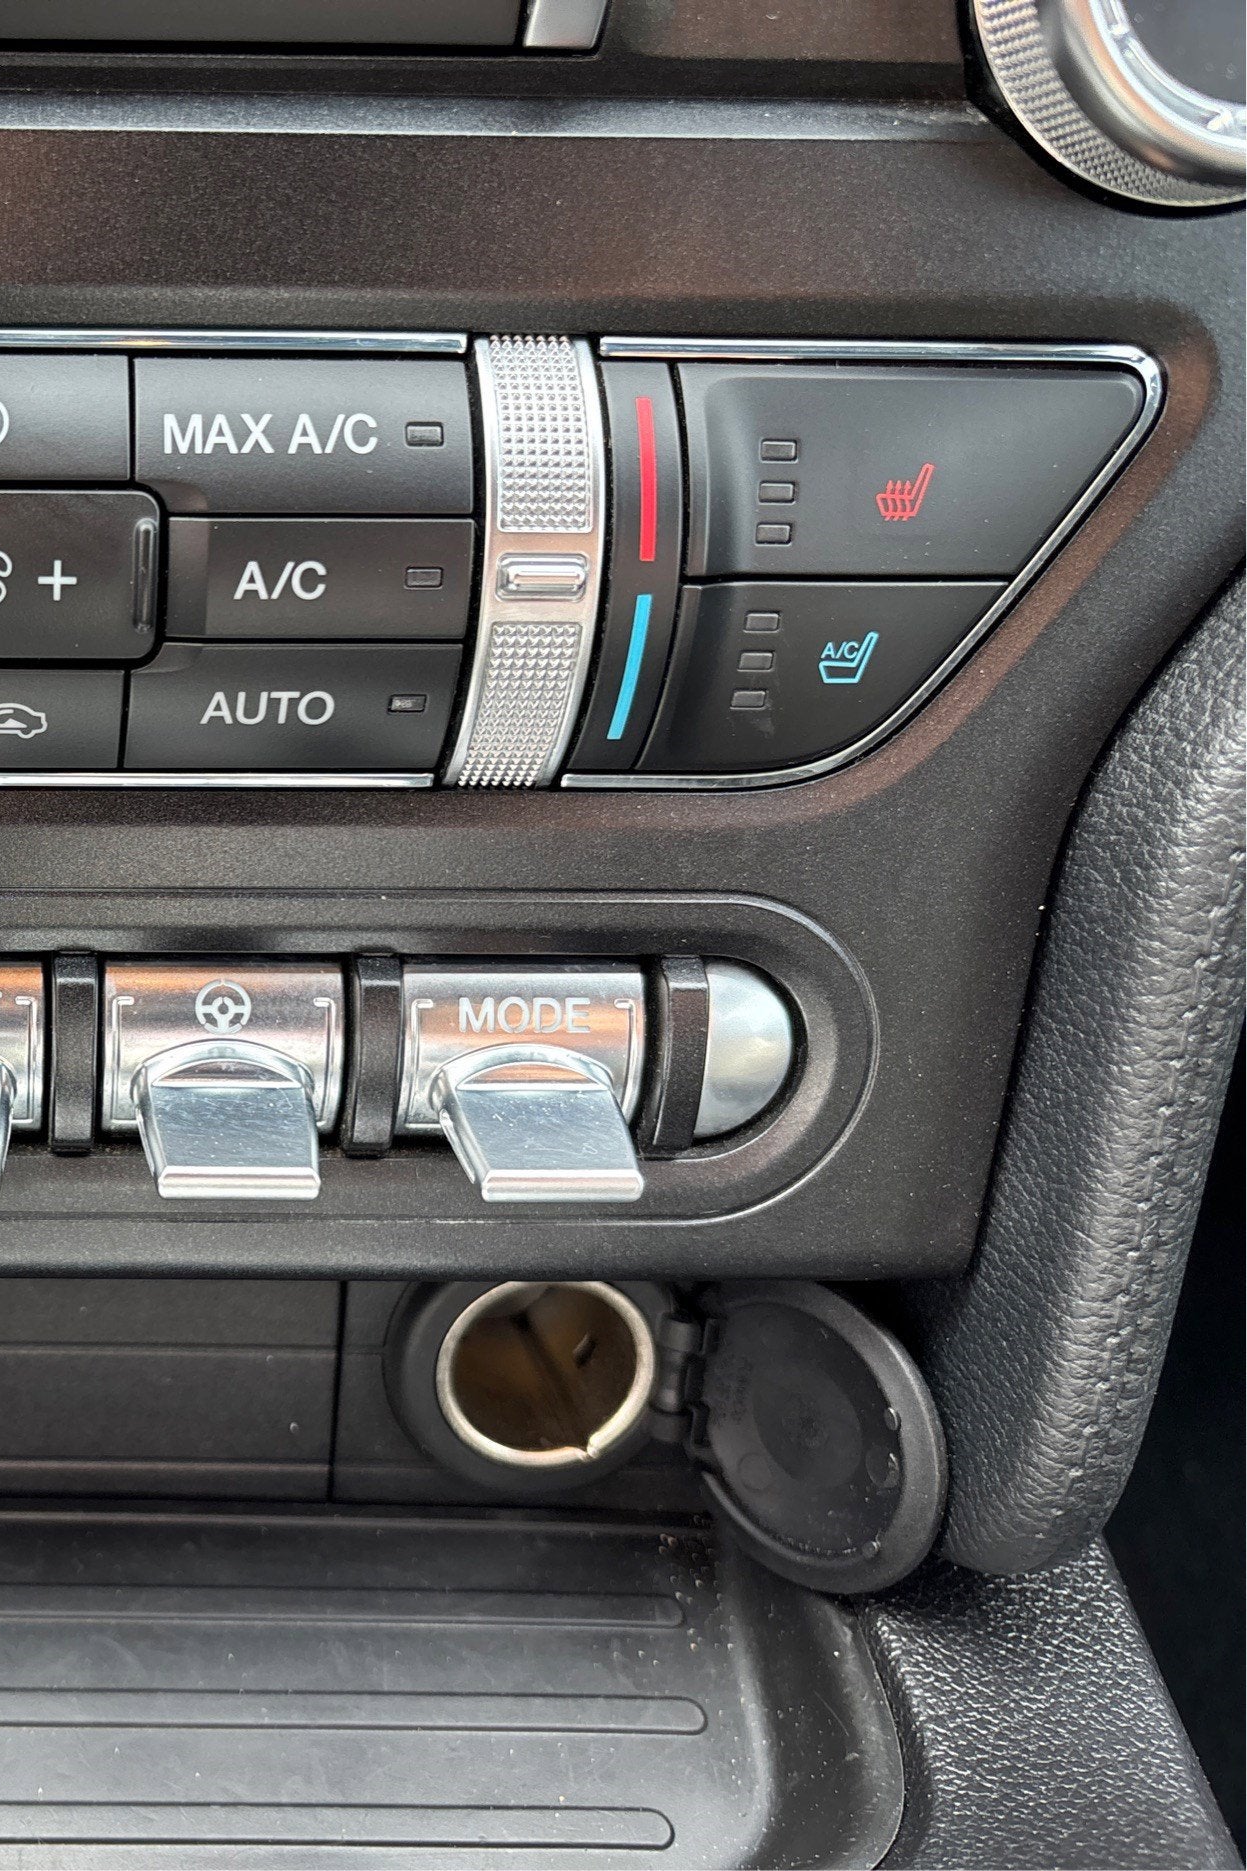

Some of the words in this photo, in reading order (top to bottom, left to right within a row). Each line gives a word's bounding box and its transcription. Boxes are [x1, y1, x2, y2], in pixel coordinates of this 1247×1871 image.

[163, 413, 274, 455] MAX
[287, 412, 379, 455] A/C
[233, 560, 327, 601] A/C
[820, 641, 859, 659] A/C
[199, 690, 336, 726] AUTO
[458, 996, 591, 1034] MODE
